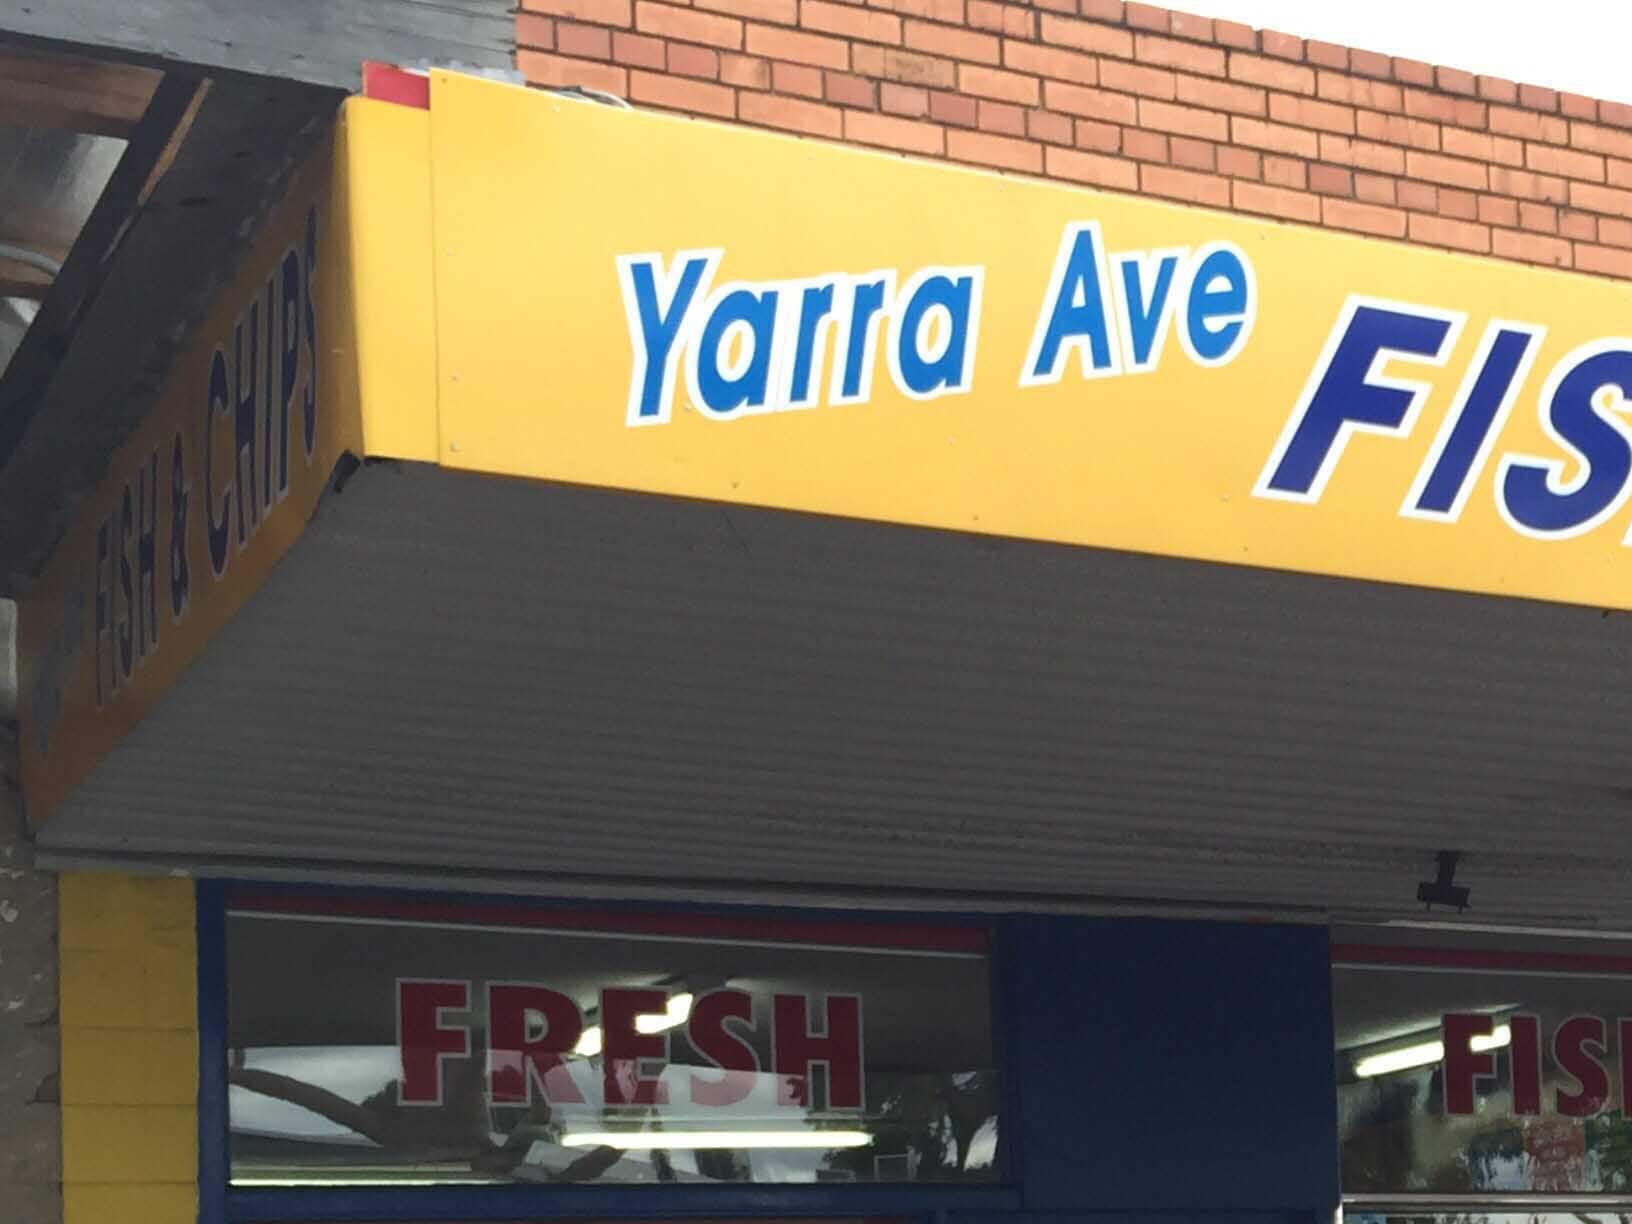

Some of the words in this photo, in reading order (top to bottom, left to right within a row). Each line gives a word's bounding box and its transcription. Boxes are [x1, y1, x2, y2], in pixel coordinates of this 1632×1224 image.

[616, 248, 985, 428] Yarra
[1018, 220, 1257, 387] Ave
[96, 445, 160, 708] FISH
[170, 430, 191, 626] &
[206, 202, 320, 583] CHIPS
[396, 978, 864, 1108] FRESH
